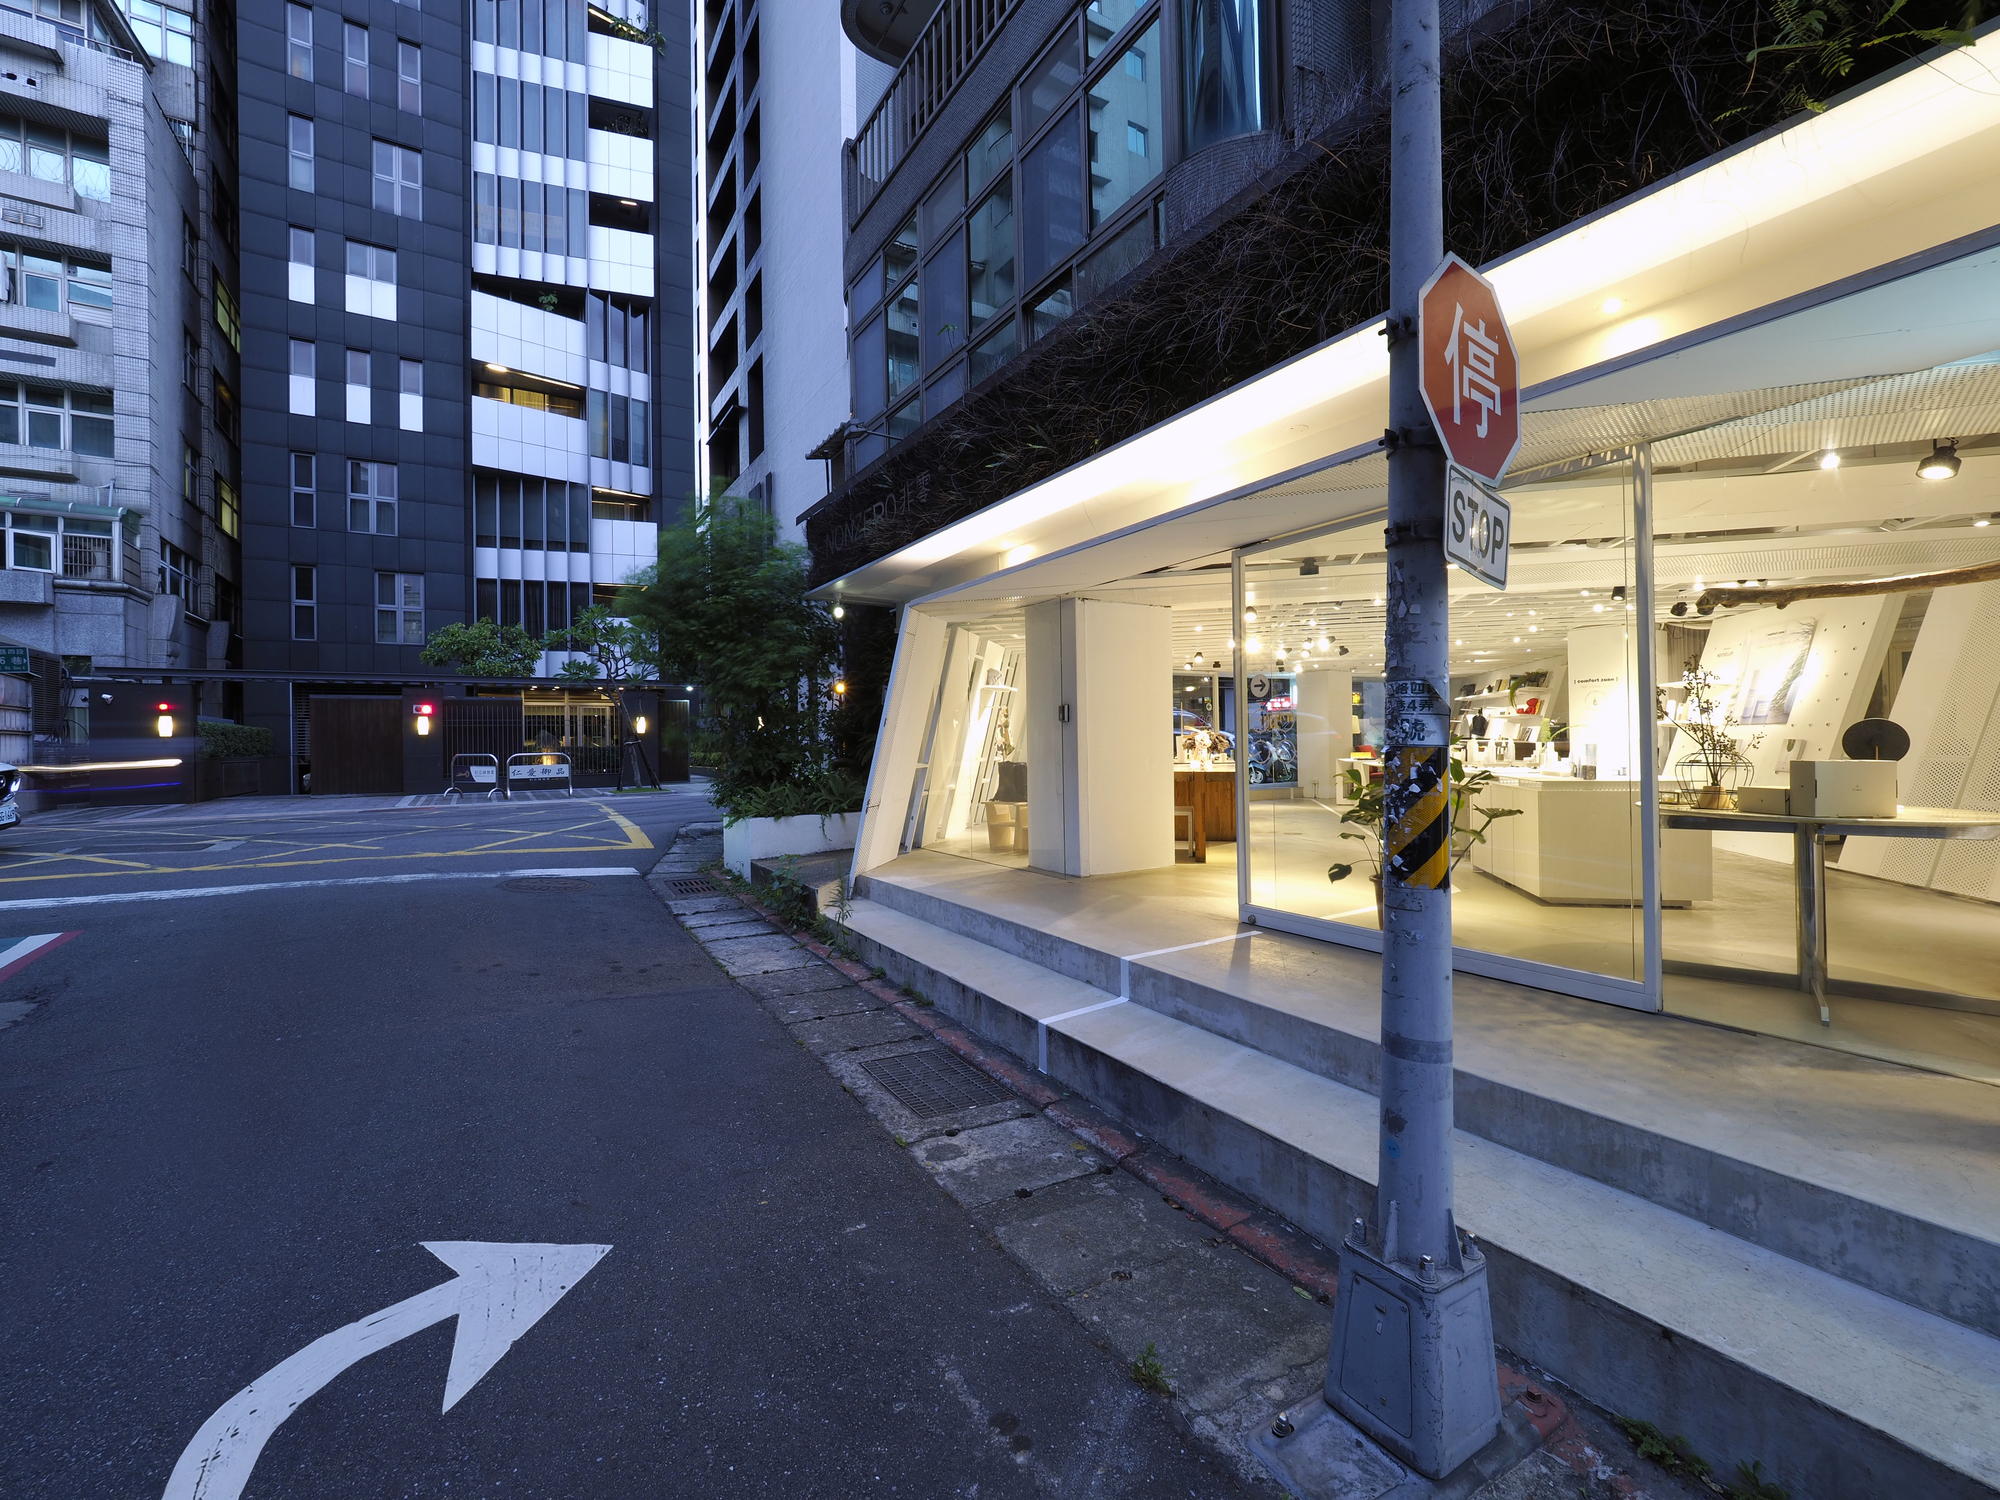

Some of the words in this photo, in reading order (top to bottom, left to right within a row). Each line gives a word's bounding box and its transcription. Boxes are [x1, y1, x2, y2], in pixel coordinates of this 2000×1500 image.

[1444, 301, 1502, 438] 停
[826, 493, 896, 557] NONZERO
[900, 470, 931, 513] 非零
[1452, 490, 1504, 565] STOP
